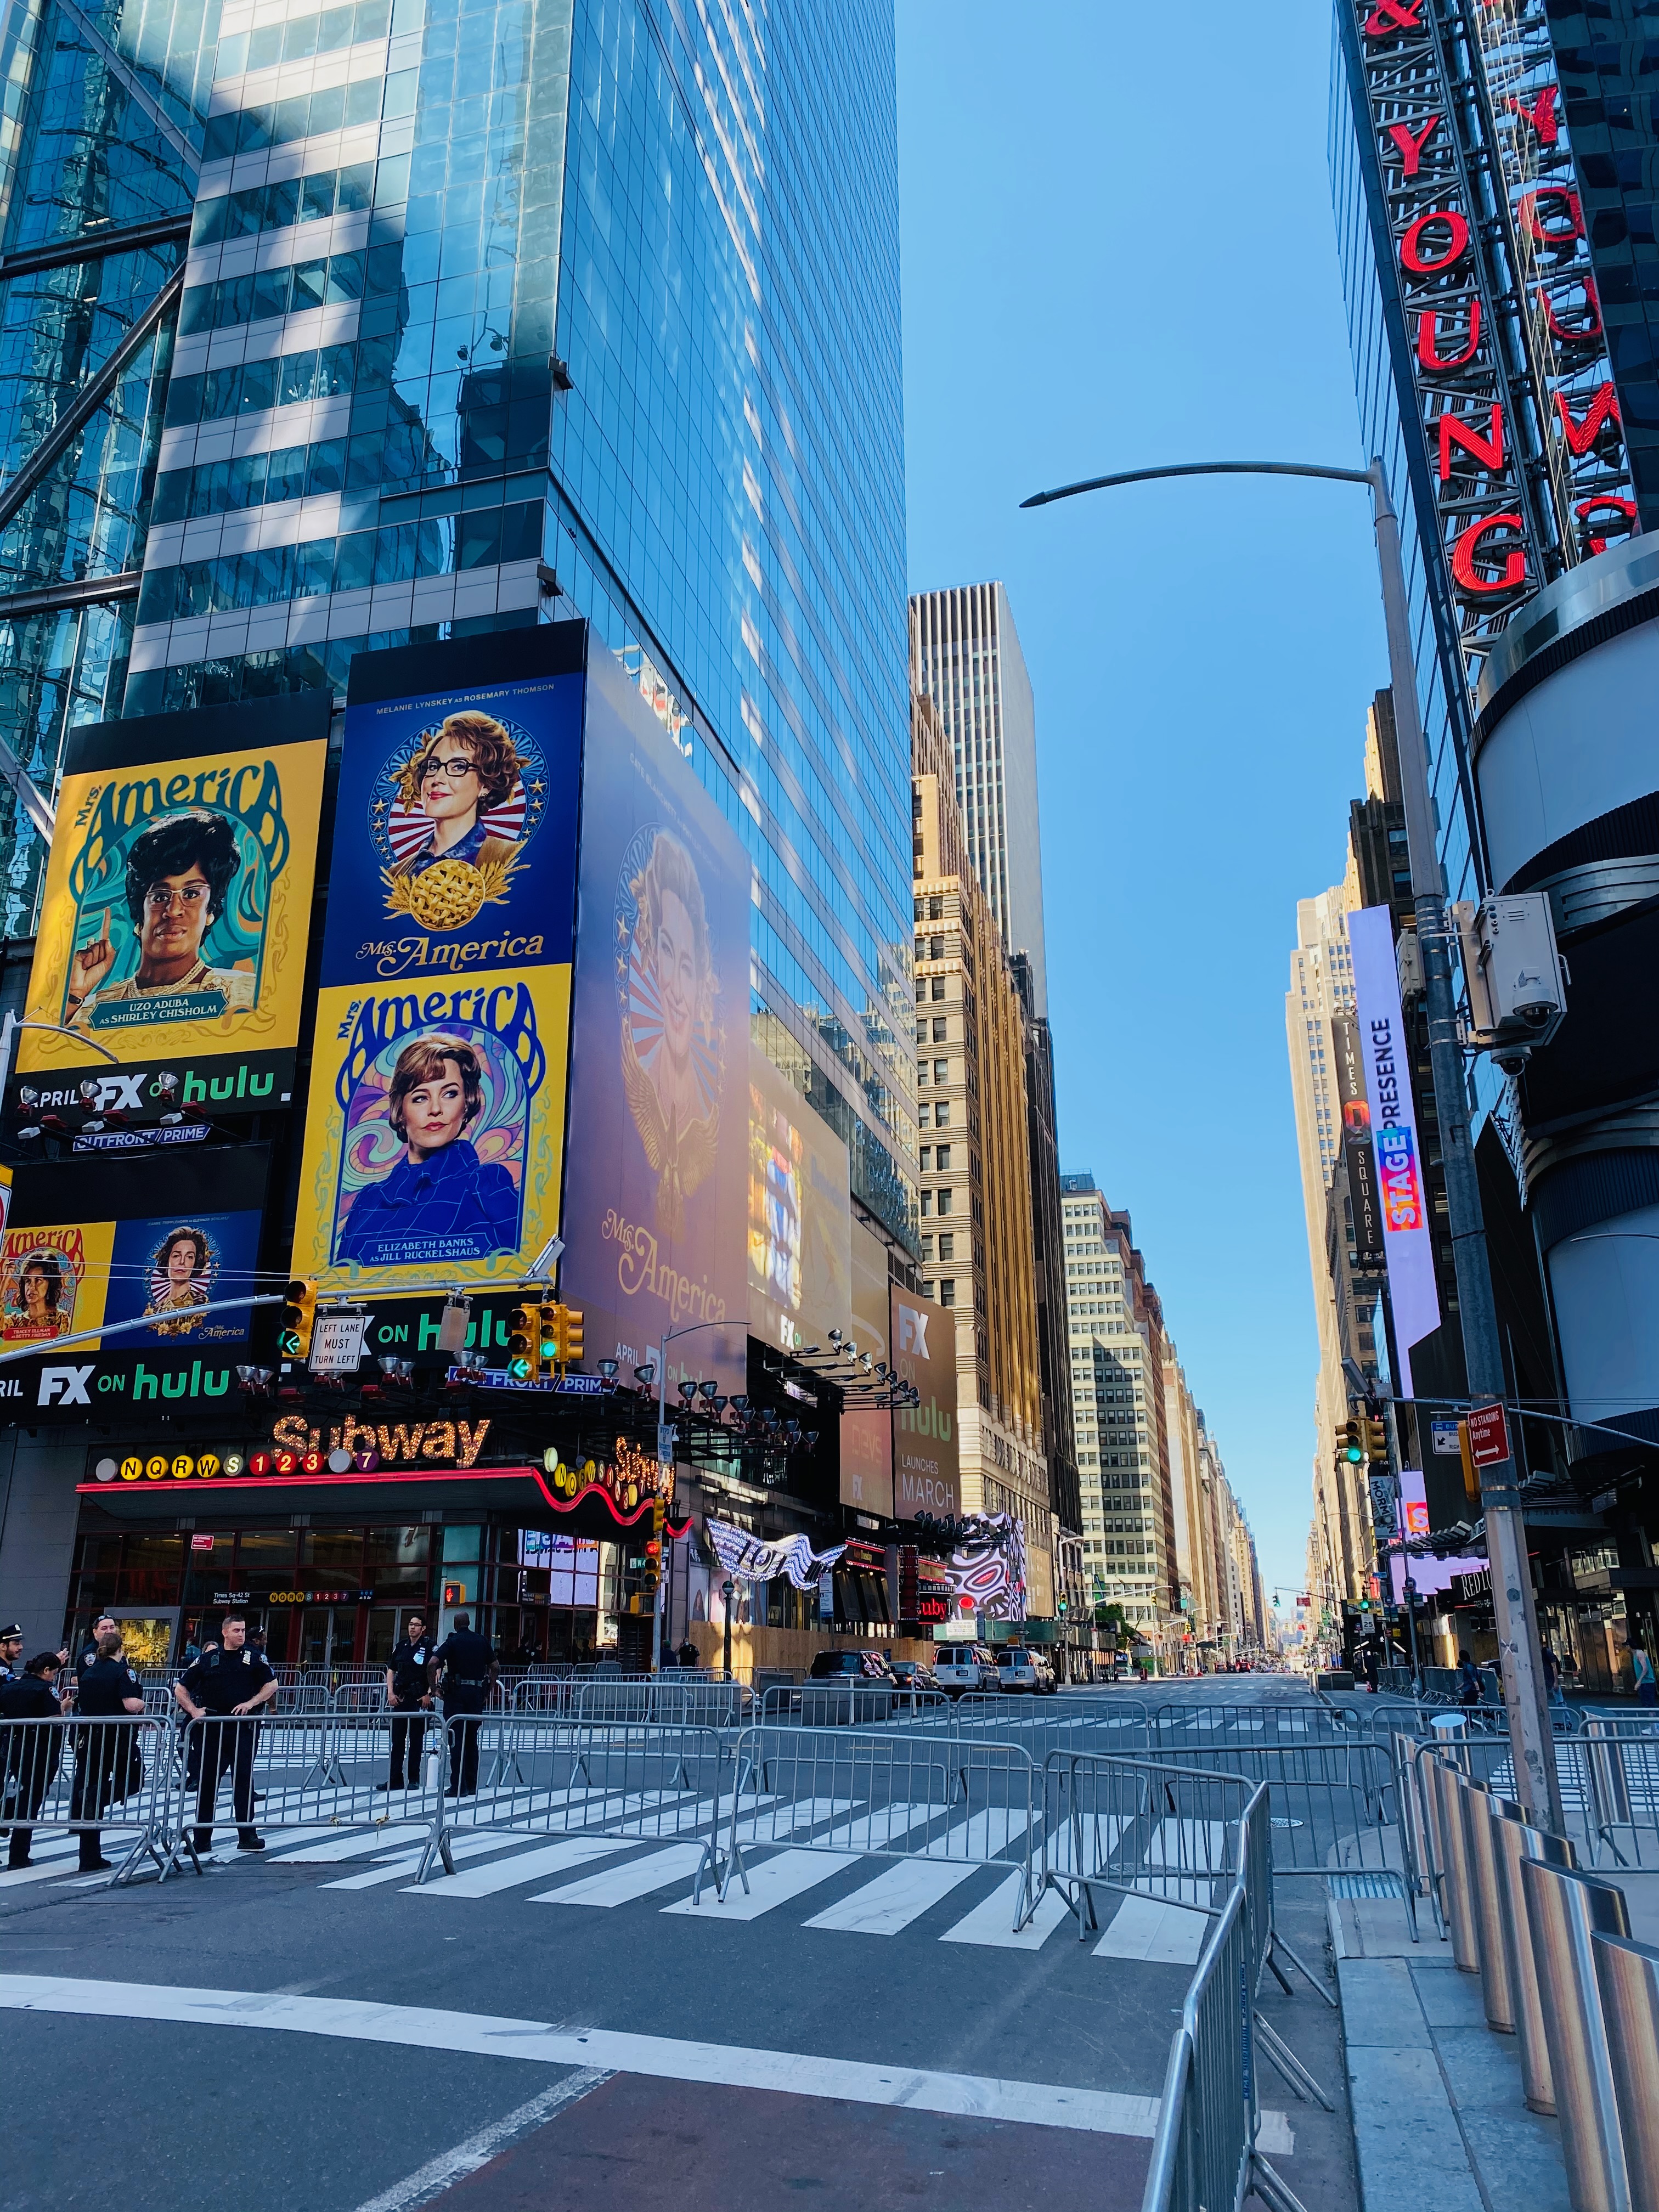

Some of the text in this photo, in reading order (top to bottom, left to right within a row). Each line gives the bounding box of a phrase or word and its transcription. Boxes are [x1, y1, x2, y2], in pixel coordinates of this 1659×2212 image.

[1389, 116, 1525, 591] YOUNG
[376, 703, 413, 715] MELANIE
[415, 697, 453, 709] LYNSKEY
[464, 690, 510, 702] ROSEMARY
[512, 683, 555, 695] THOMSON
[356, 930, 544, 977] Mrs. America
[110, 1010, 156, 1024] SHIRLEY
[159, 1004, 217, 1020] CHISHOLM
[129, 998, 189, 1012] UZO ADUBA
[30, 1090, 80, 1108] PRIL
[94, 1073, 148, 1111] FX
[182, 1065, 275, 1103] hulu
[1342, 1020, 1358, 1096] TIMES
[1357, 1150, 1374, 1245] SQUARE
[1371, 1017, 1415, 1227] STAGE PRESENCE
[77, 1127, 206, 1149] OUTFRONT PRIME
[377, 1237, 474, 1252] ELIZABETH BANKS
[380, 1251, 401, 1262] JILL
[404, 1246, 481, 1260] RUCKELSHAUS
[602, 1208, 726, 1331] Mrs. America
[198, 1327, 245, 1340] America
[319, 1324, 360, 1333] LEFT LANE
[378, 1324, 409, 1343] ON
[781, 1314, 795, 1351] FX
[898, 1303, 930, 1361] FX
[324, 1339, 350, 1349] MUST
[315, 1355, 356, 1364] TURN LEFT
[616, 1342, 640, 1368] APRIL
[668, 1364, 678, 1383] ON
[899, 1358, 916, 1382] ON
[37, 1365, 97, 1406] FX
[98, 1374, 126, 1393] ON
[132, 1361, 230, 1400] hulu
[564, 1378, 612, 1392] PRIM
[900, 1395, 951, 1443] hulu
[1470, 1410, 1499, 1428] NO STANDING
[271, 1413, 493, 1469] Subway
[1472, 1427, 1491, 1441] Anytime
[901, 1454, 939, 1475] LAUNCHES
[852, 1474, 863, 1502] FX
[901, 1474, 955, 1510] MARCH
[1460, 1572, 1481, 1601] RED
[921, 1598, 946, 1620] uby
